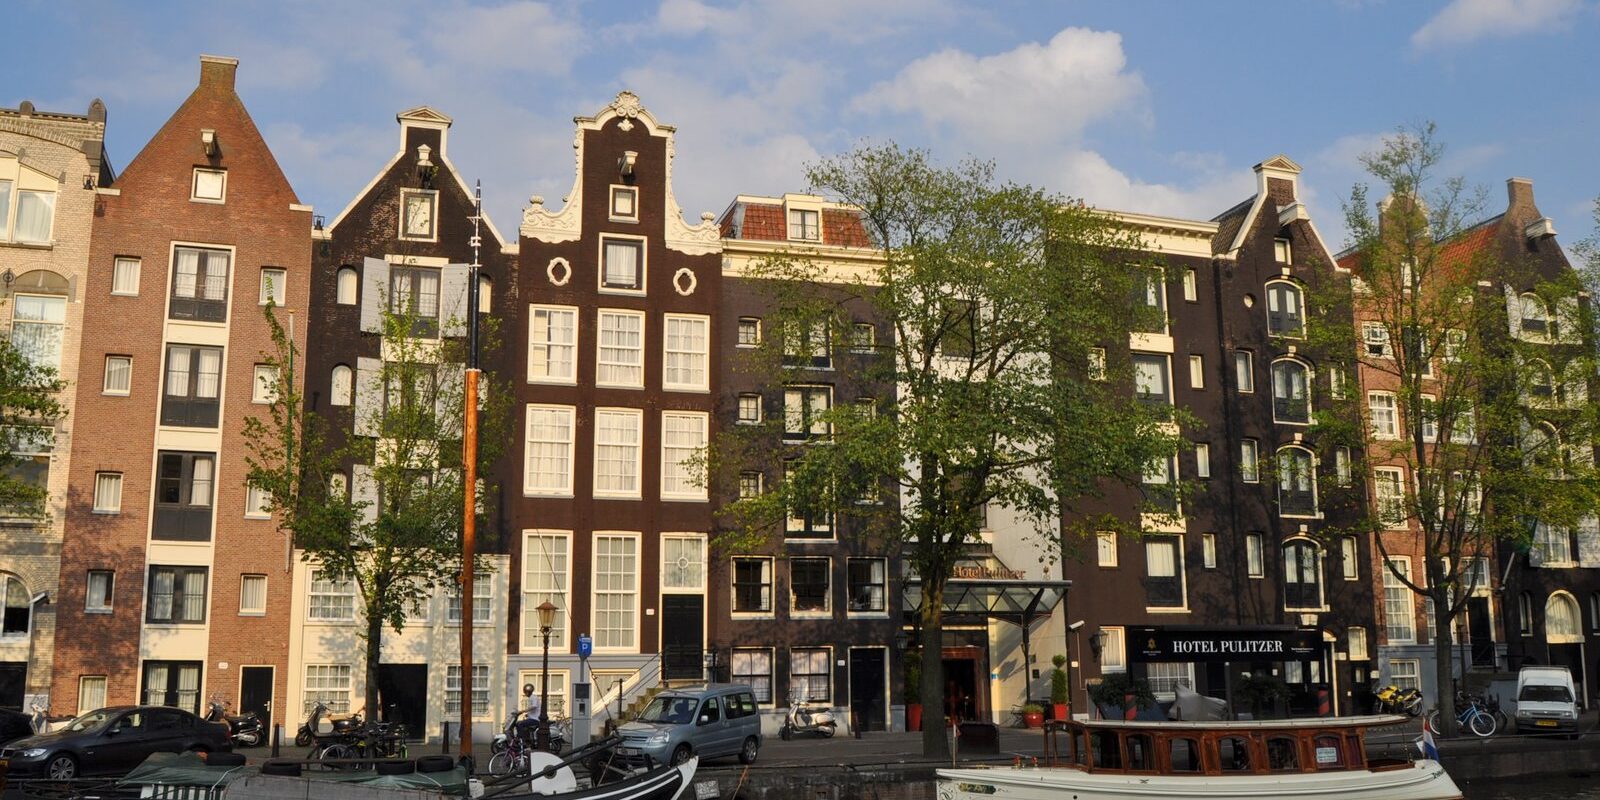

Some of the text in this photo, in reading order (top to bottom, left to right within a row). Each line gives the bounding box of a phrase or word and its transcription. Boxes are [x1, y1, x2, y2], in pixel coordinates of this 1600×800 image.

[953, 566, 981, 579] Hotel
[1172, 640, 1218, 653] HOTEL
[1220, 640, 1283, 653] PULITZER
